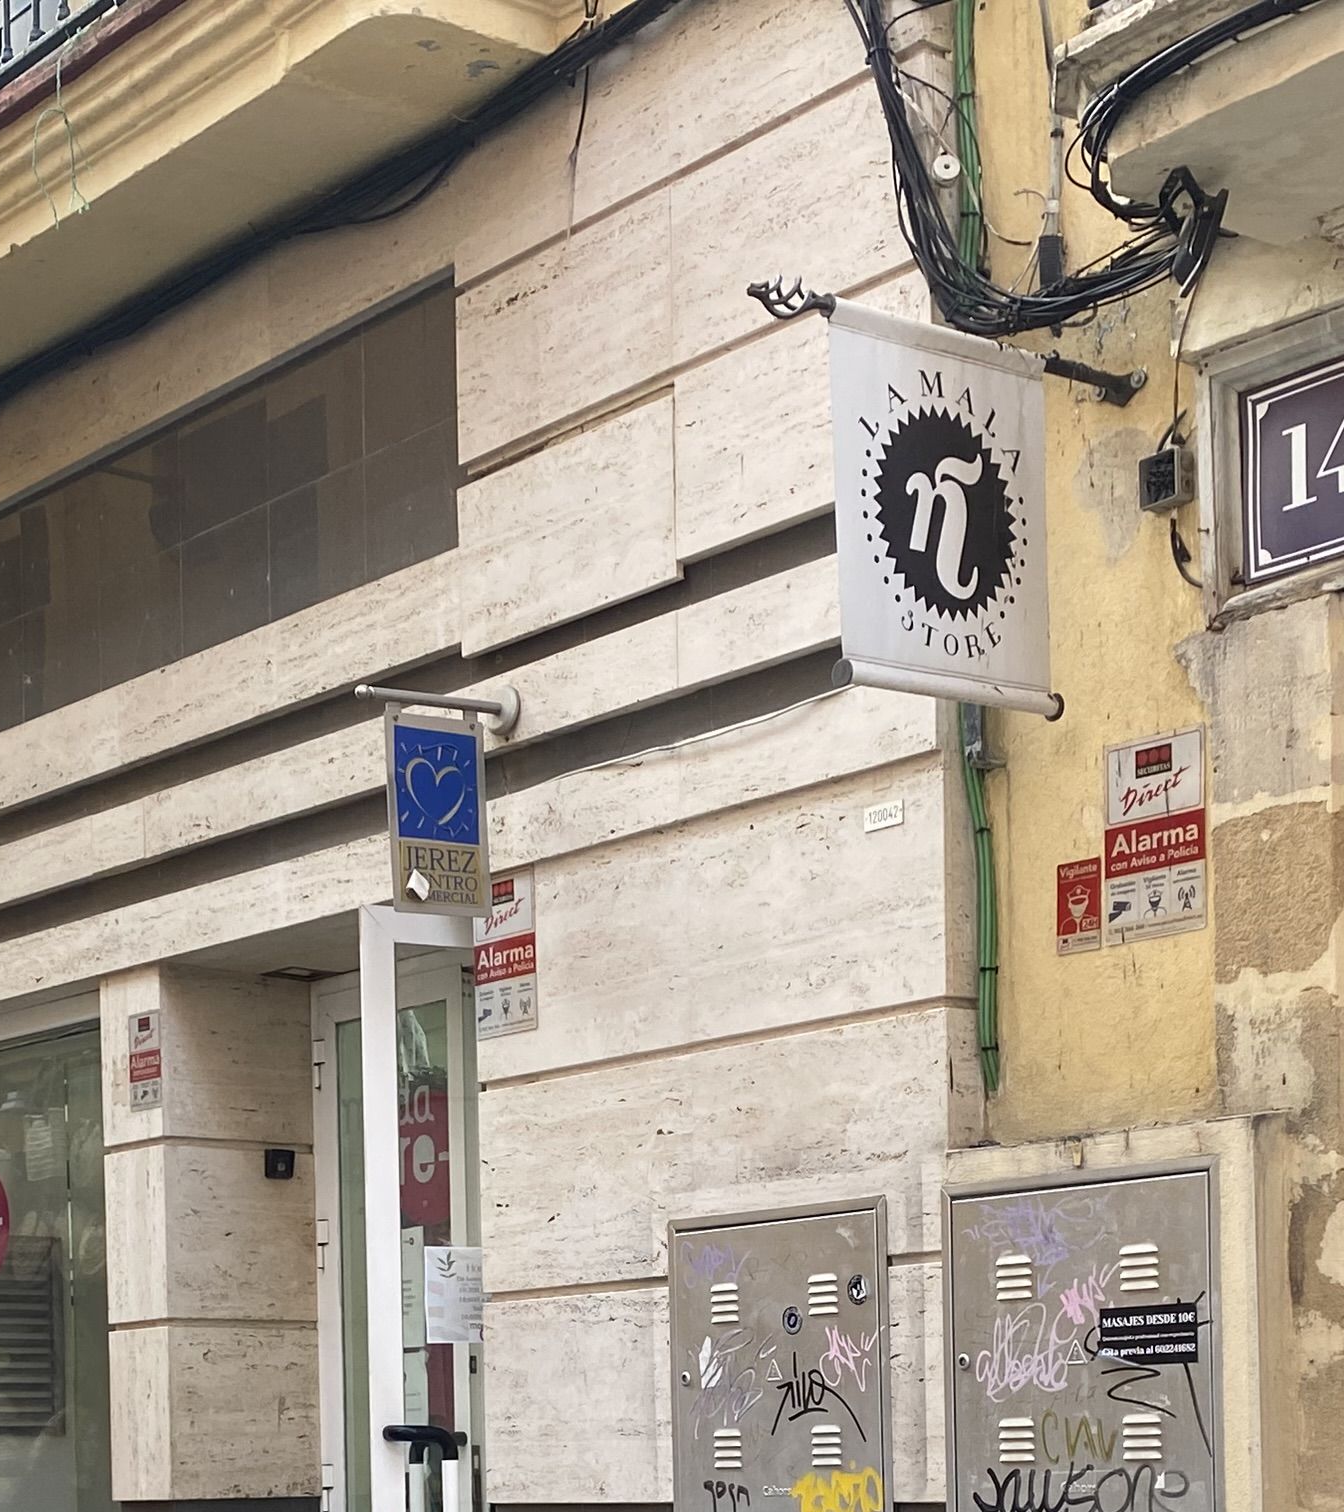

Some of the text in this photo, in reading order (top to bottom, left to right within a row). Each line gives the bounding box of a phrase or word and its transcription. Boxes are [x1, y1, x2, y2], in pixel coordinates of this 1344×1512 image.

[901, 610, 1003, 659] STORE
[1120, 765, 1191, 817] Direct
[868, 804, 899, 825] 120042
[1110, 823, 1199, 858] Alarma
[405, 845, 477, 874] JEREZ
[1059, 864, 1098, 879] Vigilante
[1110, 844, 1199, 872] con Aviso a Policía
[408, 872, 478, 893] NTRO
[484, 896, 525, 936] Direct
[1082, 919, 1097, 930] 24H
[477, 943, 534, 970] Alarma
[130, 1054, 160, 1070] Alarma
[1102, 1311, 1196, 1328] MASAJES DESDE 10€
